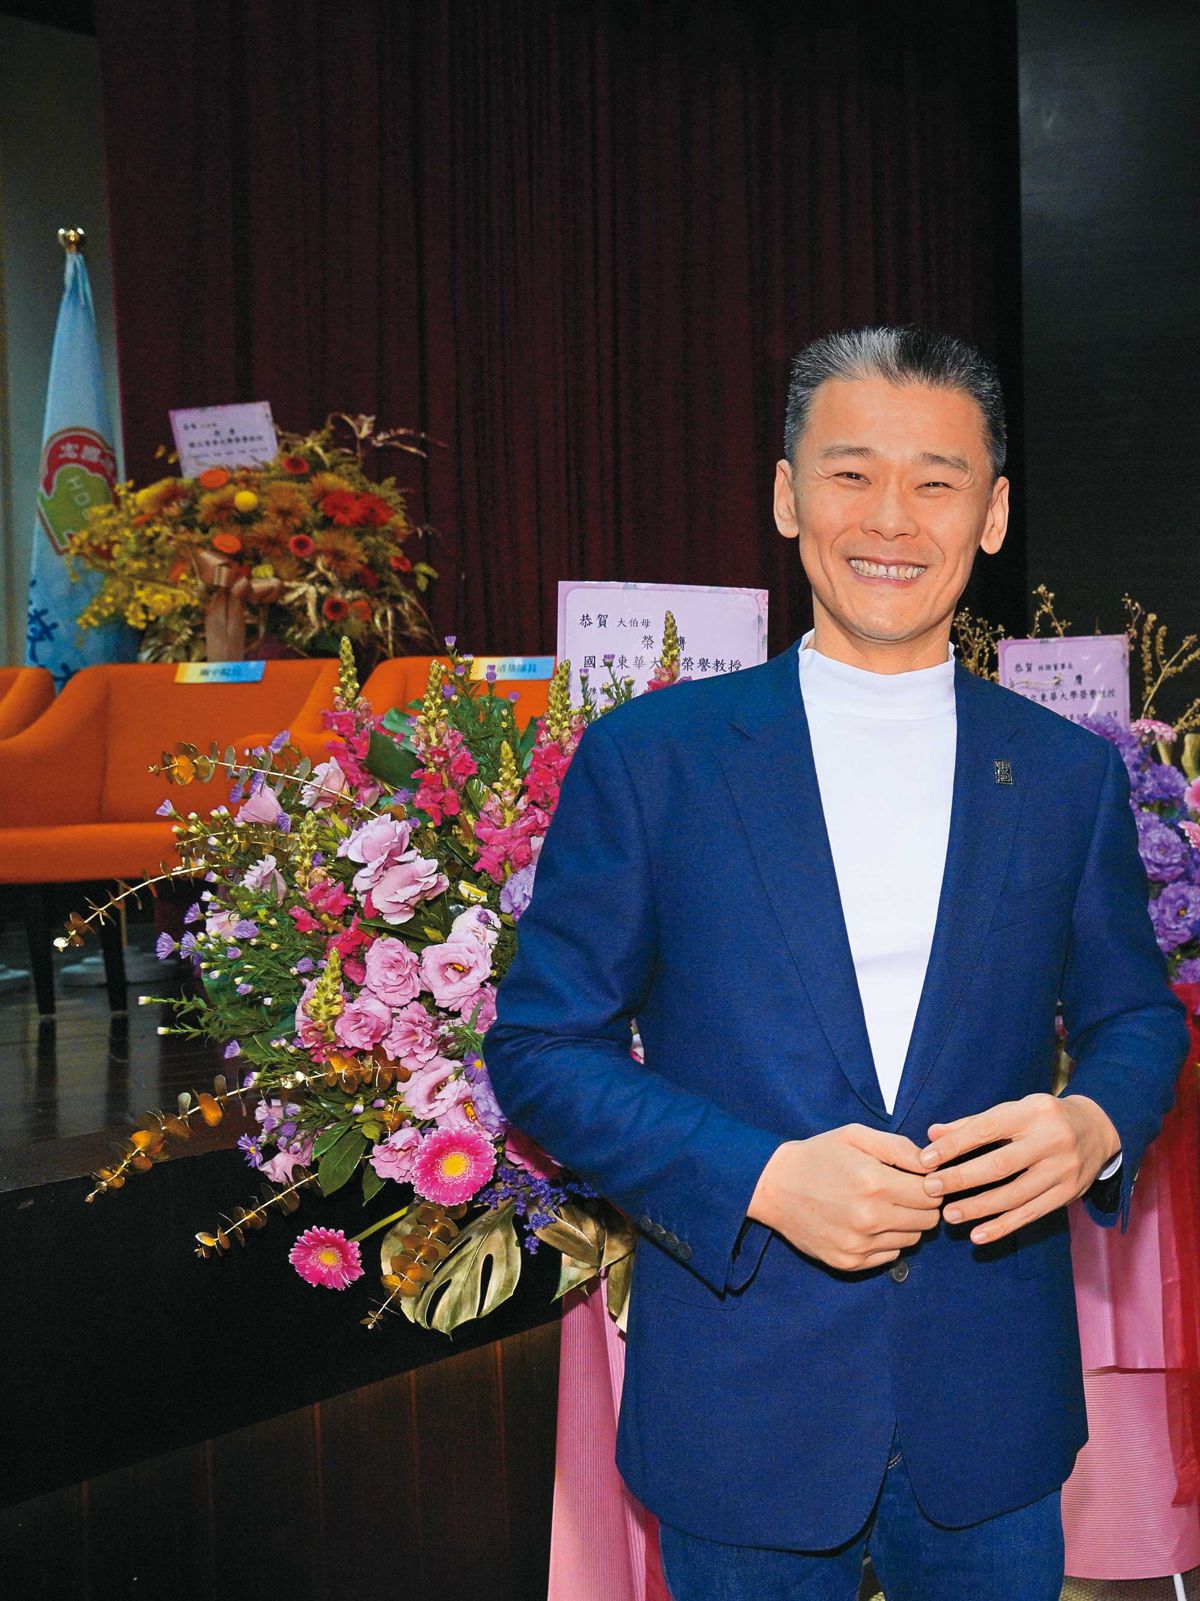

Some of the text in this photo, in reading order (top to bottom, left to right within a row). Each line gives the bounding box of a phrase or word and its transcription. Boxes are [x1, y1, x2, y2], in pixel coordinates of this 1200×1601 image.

[579, 613, 652, 629] 恭賀 大伯母
[641, 635, 655, 650] 榮
[583, 654, 743, 673] 國東華大榮譽教授
[1014, 662, 1033, 673] 恭賀
